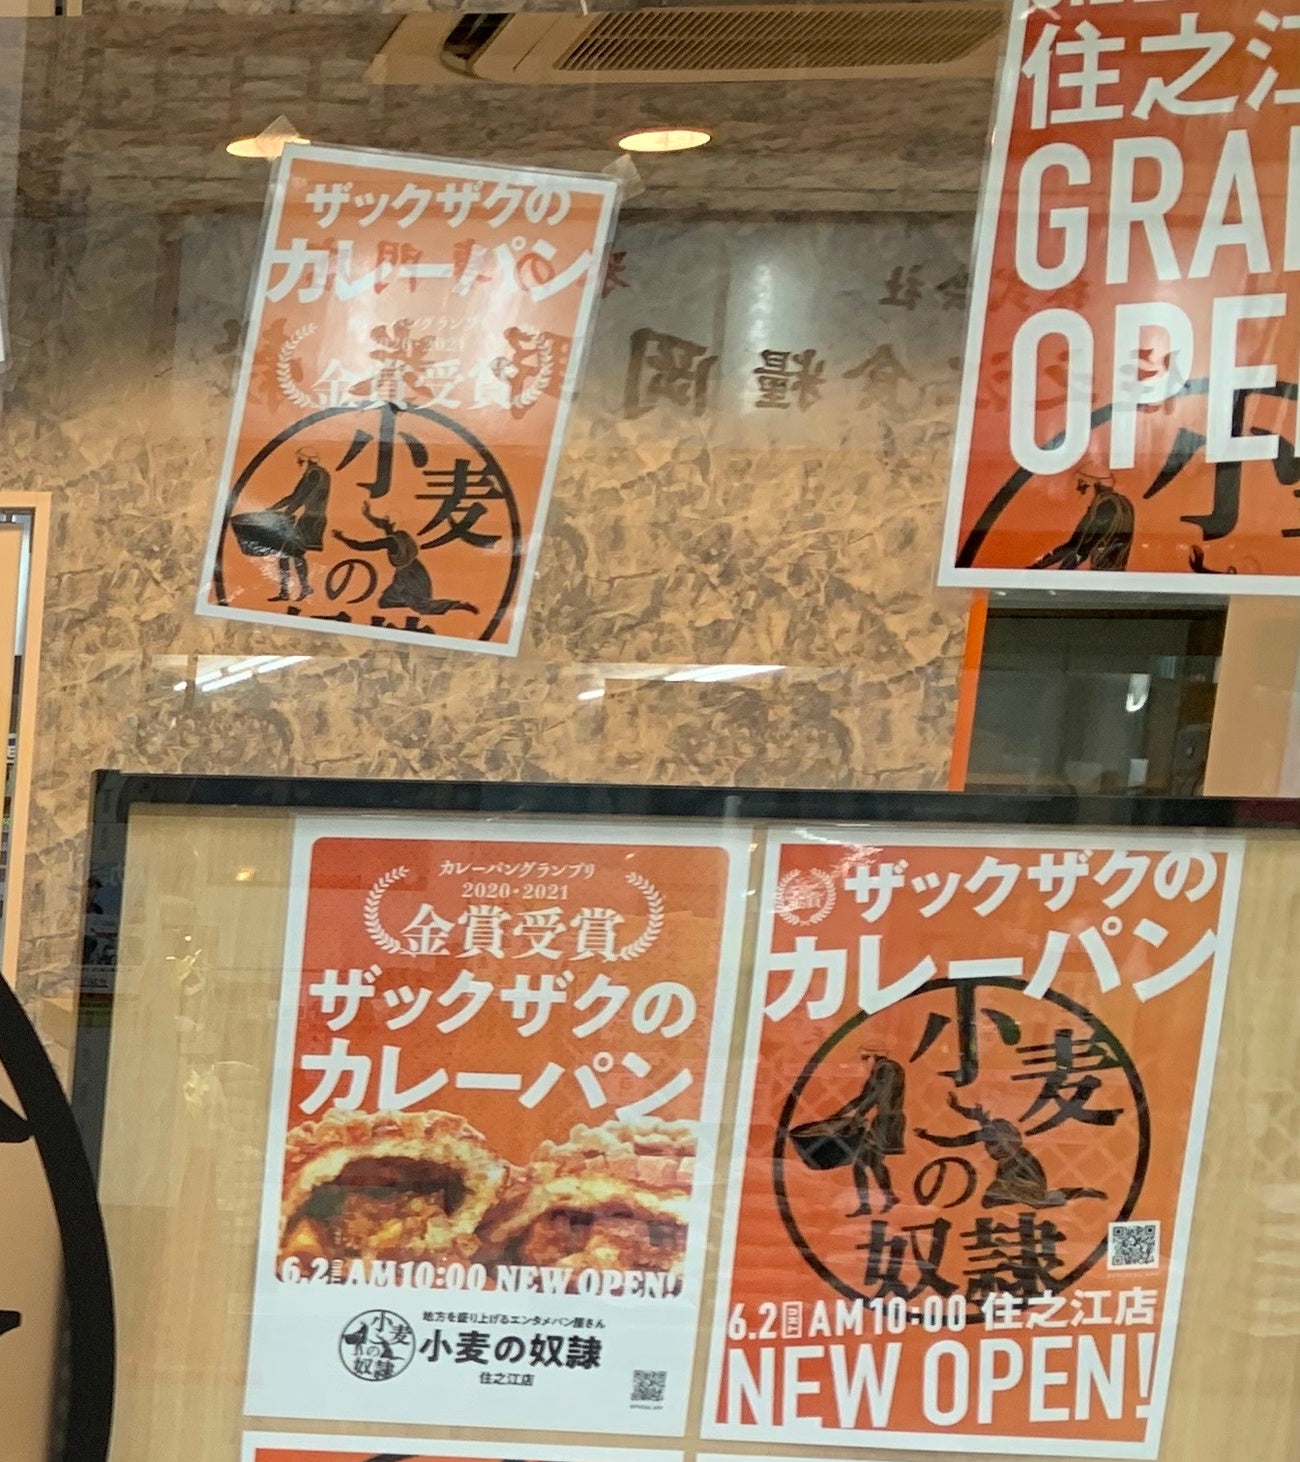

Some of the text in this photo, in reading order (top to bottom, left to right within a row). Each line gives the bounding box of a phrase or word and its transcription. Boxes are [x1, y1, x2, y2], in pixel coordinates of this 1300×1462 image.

[306, 182, 571, 229] ザックザクの
[1016, 130, 1300, 290] GRA
[264, 235, 596, 304] カレーパン
[1010, 294, 1300, 475] OPE
[337, 404, 506, 549] 小麦
[326, 559, 377, 603] の
[438, 860, 595, 880] カレーパングランプリ
[845, 849, 1216, 921] ザックザクの
[400, 904, 626, 962] 金賞受賞
[309, 965, 697, 1039] ザックザクの
[764, 918, 1216, 1021] カレーパン
[300, 1039, 693, 1121] カレーパン
[910, 978, 1124, 1136] 小麦
[915, 1157, 978, 1209] の
[346, 1261, 487, 1290] AM10:00
[497, 1267, 570, 1296] NEW
[578, 1269, 683, 1299] OPEN!
[858, 1213, 1068, 1307] 奴隷
[420, 1331, 603, 1369] 小麦の奴隷
[728, 1302, 777, 1341] 6.2
[809, 1297, 966, 1337] AM10:00
[983, 1289, 1157, 1331] 住之江店
[480, 1373, 534, 1387] 住之江店
[727, 1334, 1157, 1430] NEW OPEN!
